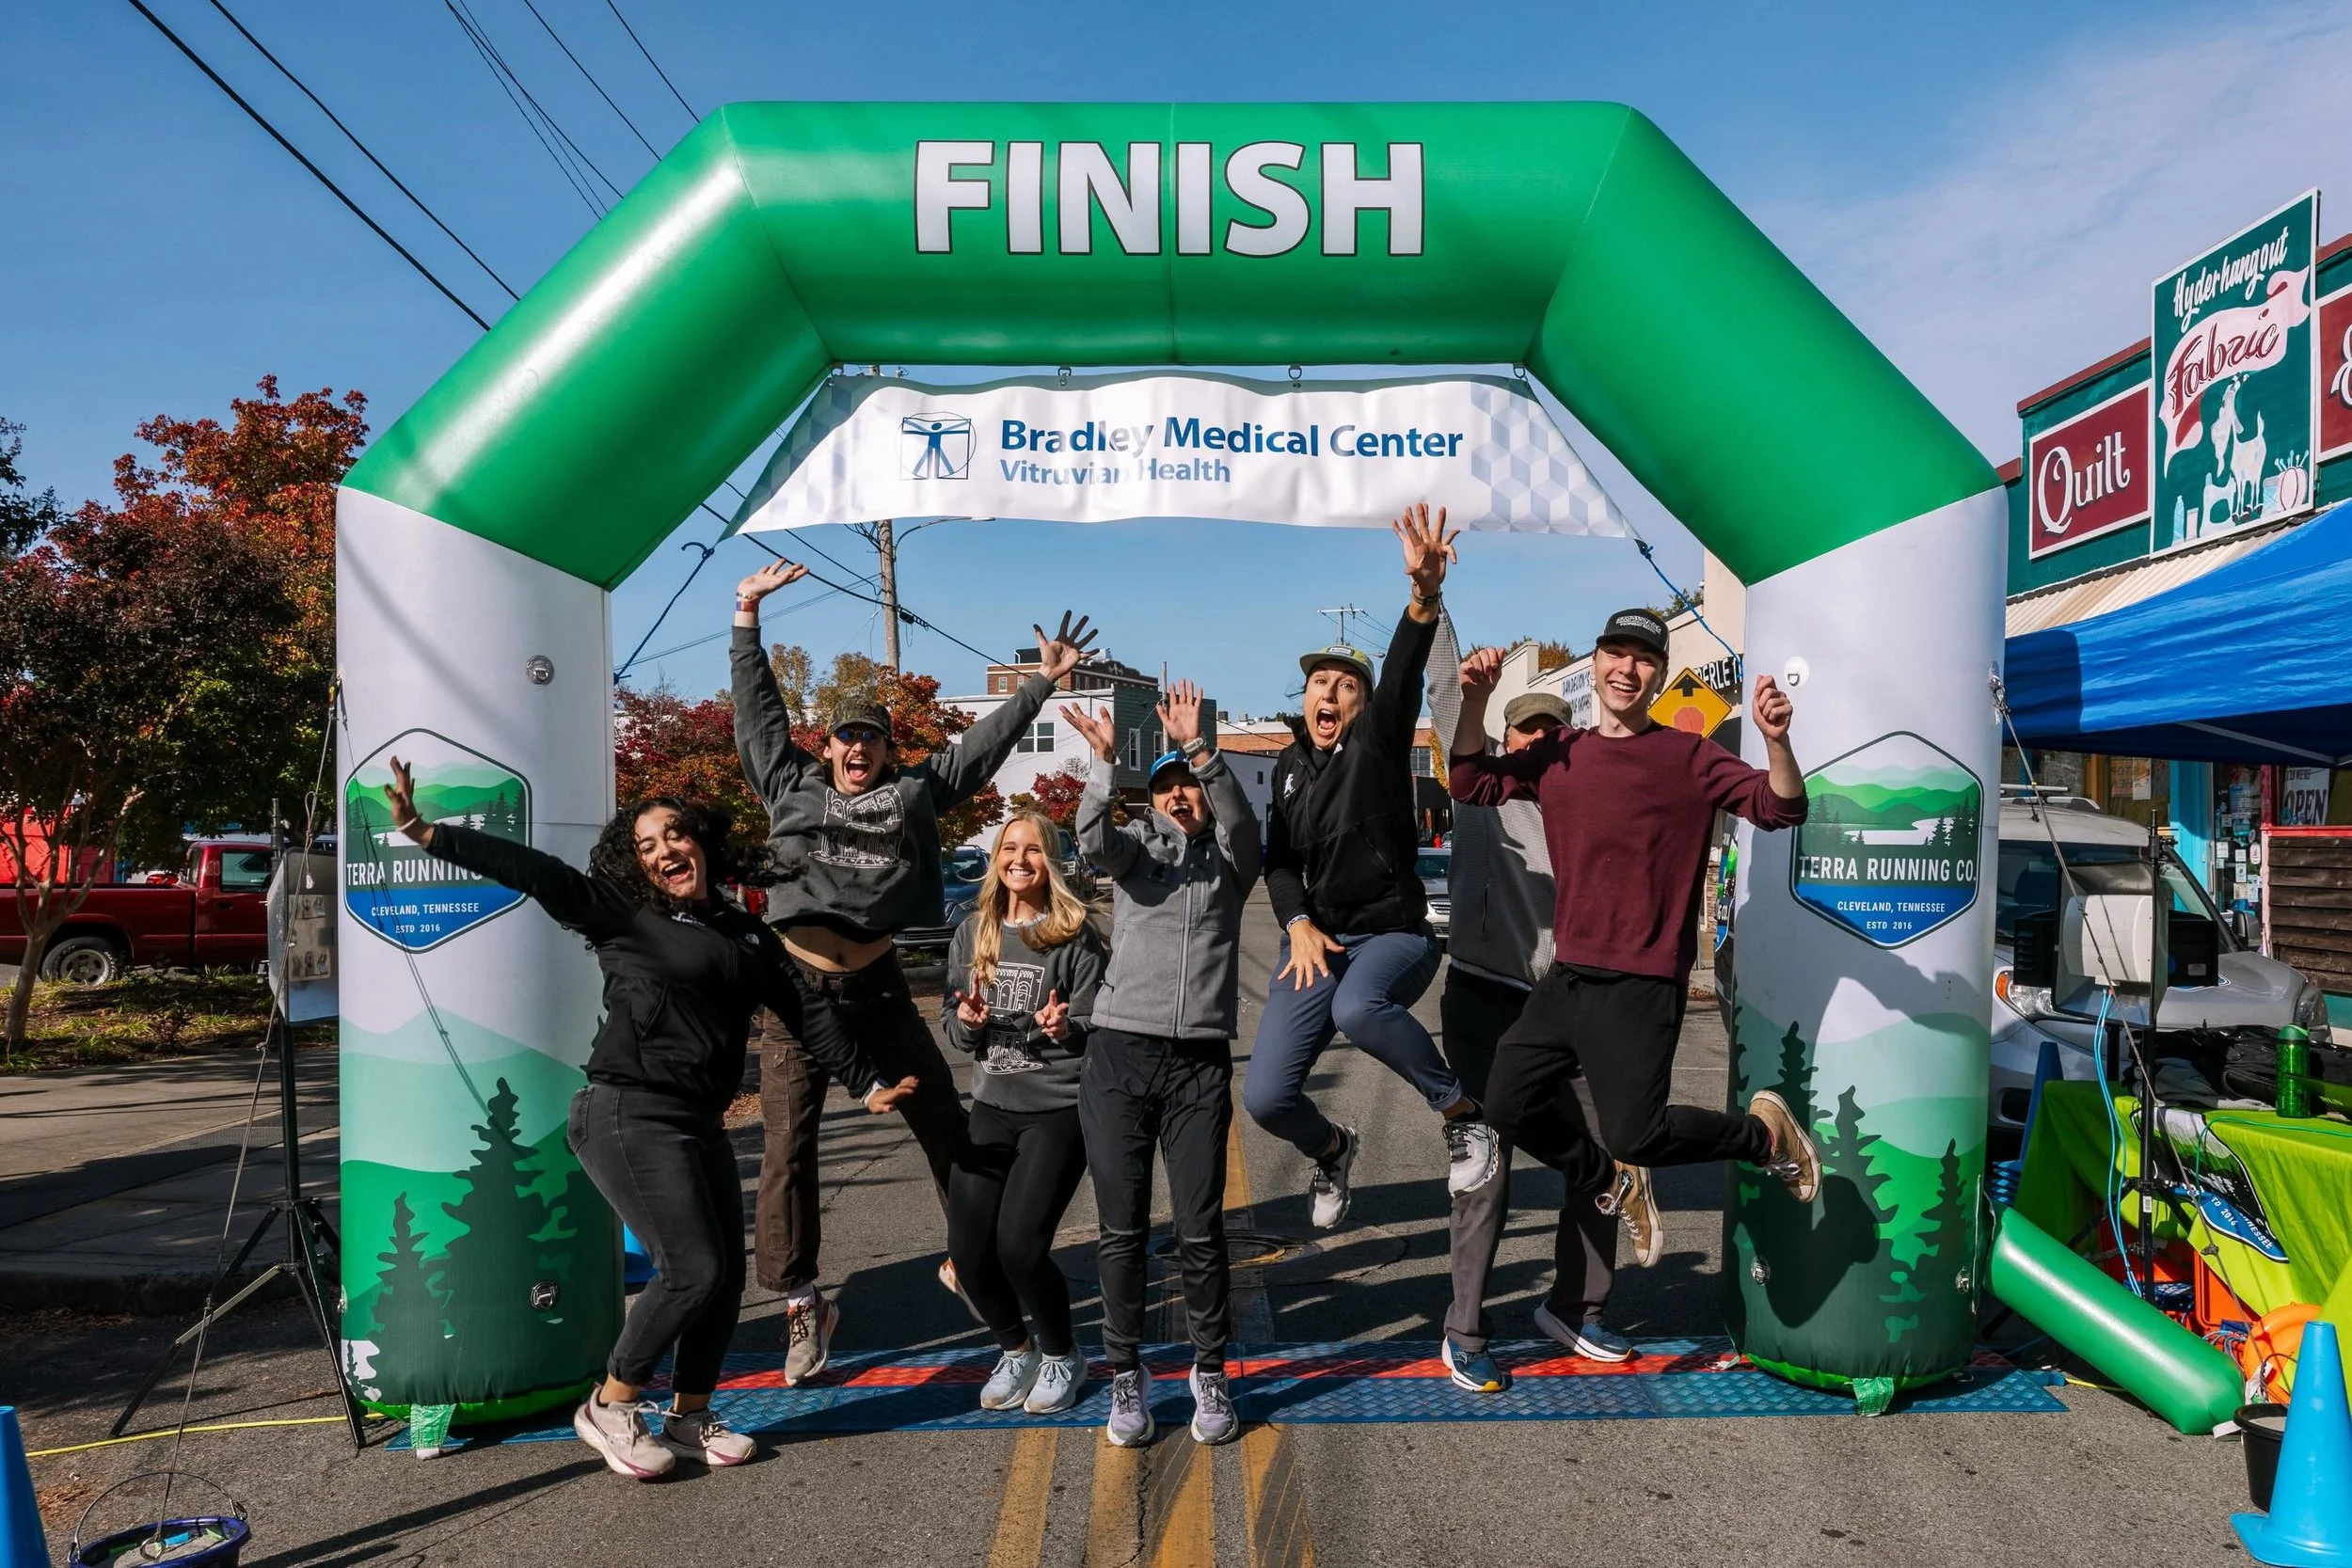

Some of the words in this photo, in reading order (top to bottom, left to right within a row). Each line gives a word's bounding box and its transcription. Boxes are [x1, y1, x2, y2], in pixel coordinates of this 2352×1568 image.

[914, 140, 1424, 258] FINISH
[2168, 308, 2280, 420] Fabric
[1001, 419, 1154, 458] Bradley
[1164, 417, 1319, 457] Medical
[1329, 424, 1464, 457] Center
[999, 459, 1130, 484] Vitruvian
[1137, 457, 1232, 483] Health
[2038, 431, 2131, 535] Quilt
[2283, 788, 2328, 825] OPEN
[346, 862, 387, 886] TERRA
[1799, 856, 1858, 880] TERRA
[1867, 858, 1950, 881] RUNNING
[1956, 859, 1977, 881] CO.
[371, 905, 421, 917] CLEVELAND,
[423, 902, 480, 914] TENNESSEE
[1837, 901, 1894, 913] CLEVELAND,
[1897, 902, 1946, 912] TENNESSEE
[395, 925, 415, 934] ESTD
[420, 924, 441, 933] 2016
[1867, 921, 1888, 929] ESTD
[1893, 921, 1913, 930] 2016
[2220, 1208, 2238, 1227] 2016
